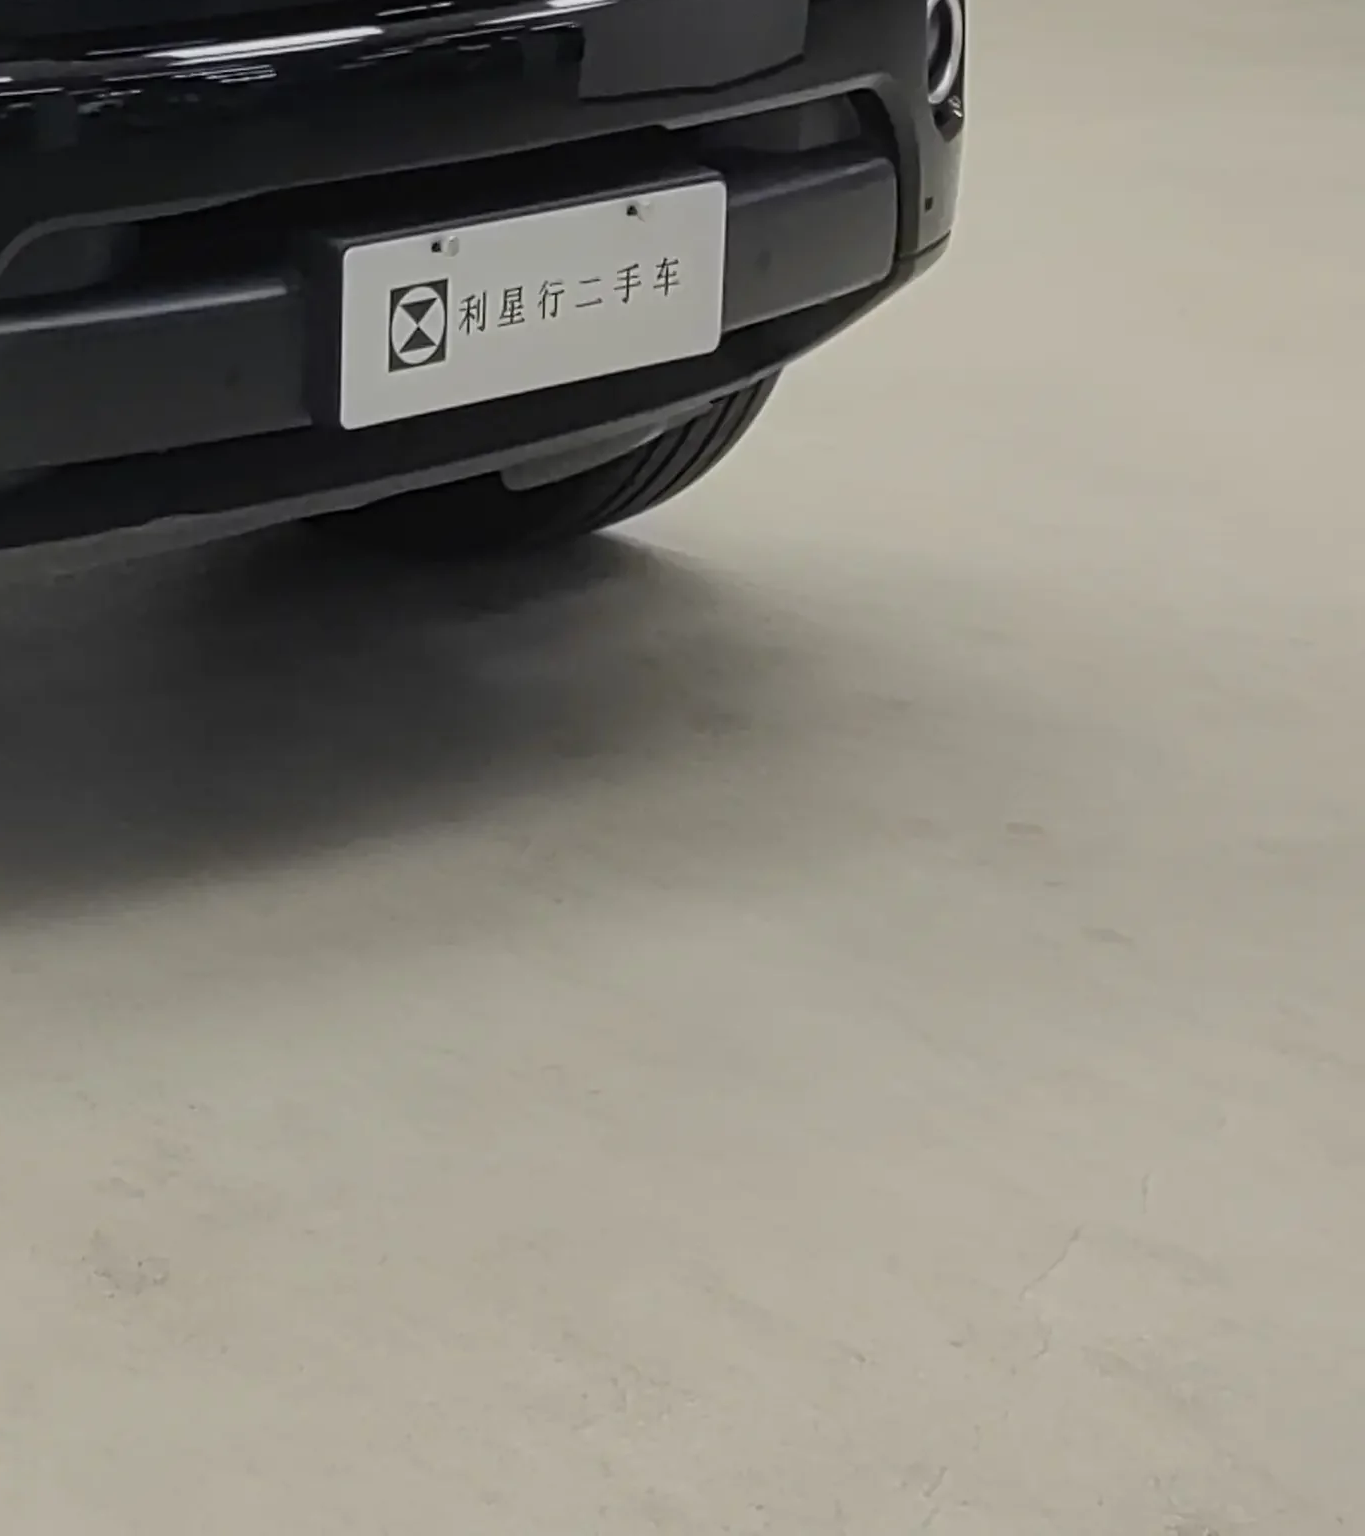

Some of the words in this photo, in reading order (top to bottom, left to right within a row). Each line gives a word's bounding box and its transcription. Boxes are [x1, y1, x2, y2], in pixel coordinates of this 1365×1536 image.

[457, 257, 680, 336] 利星行二手车
